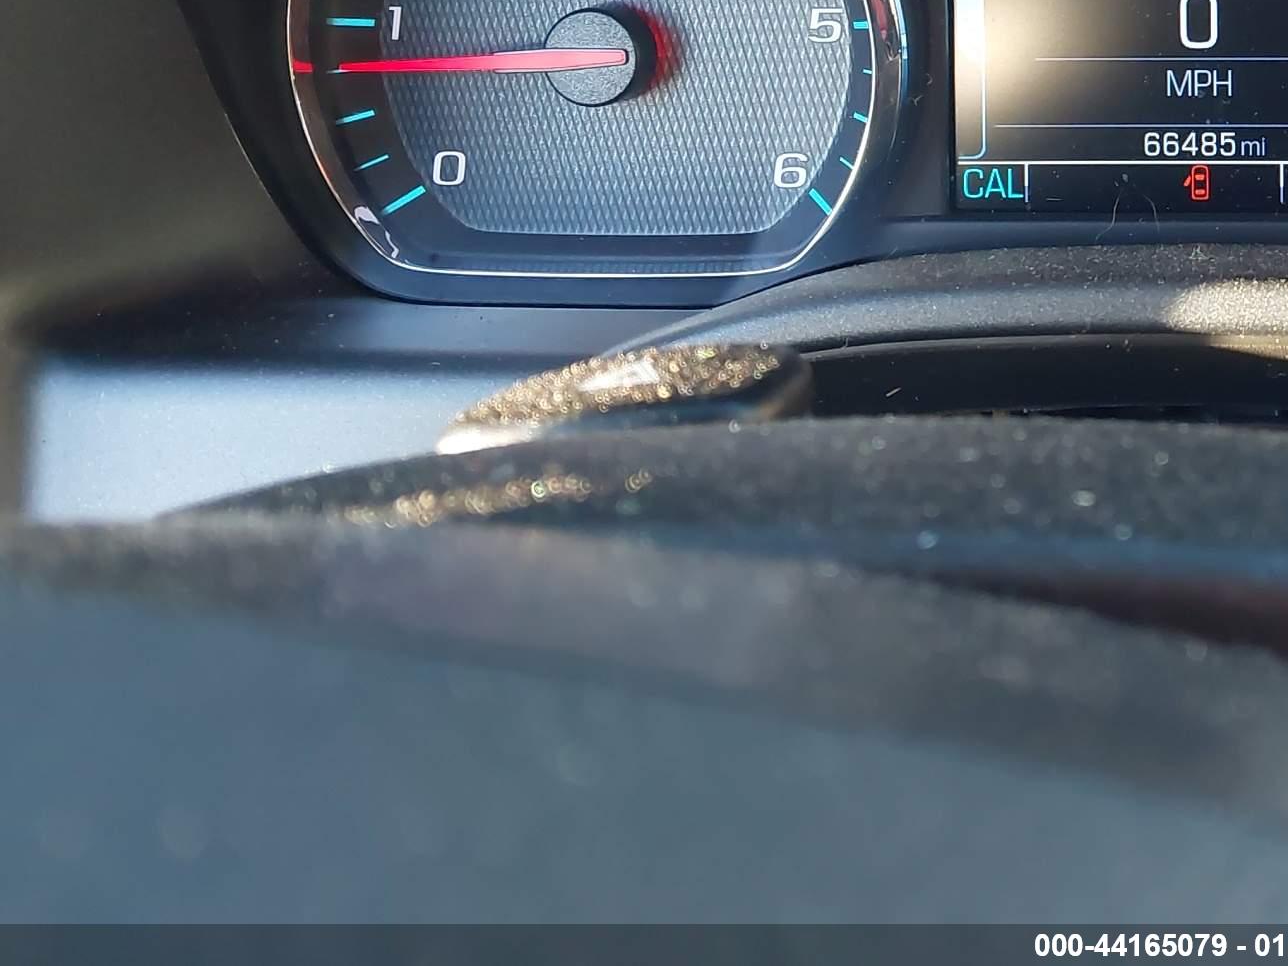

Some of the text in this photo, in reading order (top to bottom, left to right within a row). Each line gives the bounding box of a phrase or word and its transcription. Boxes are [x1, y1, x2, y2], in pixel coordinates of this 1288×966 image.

[387, 6, 403, 40] 1
[808, 7, 843, 43] 5
[1166, 69, 1233, 97] MPH
[1143, 132, 1266, 157] 66485 mi
[432, 151, 466, 186] 0
[773, 153, 808, 188] 6
[962, 168, 1024, 199] CAL
